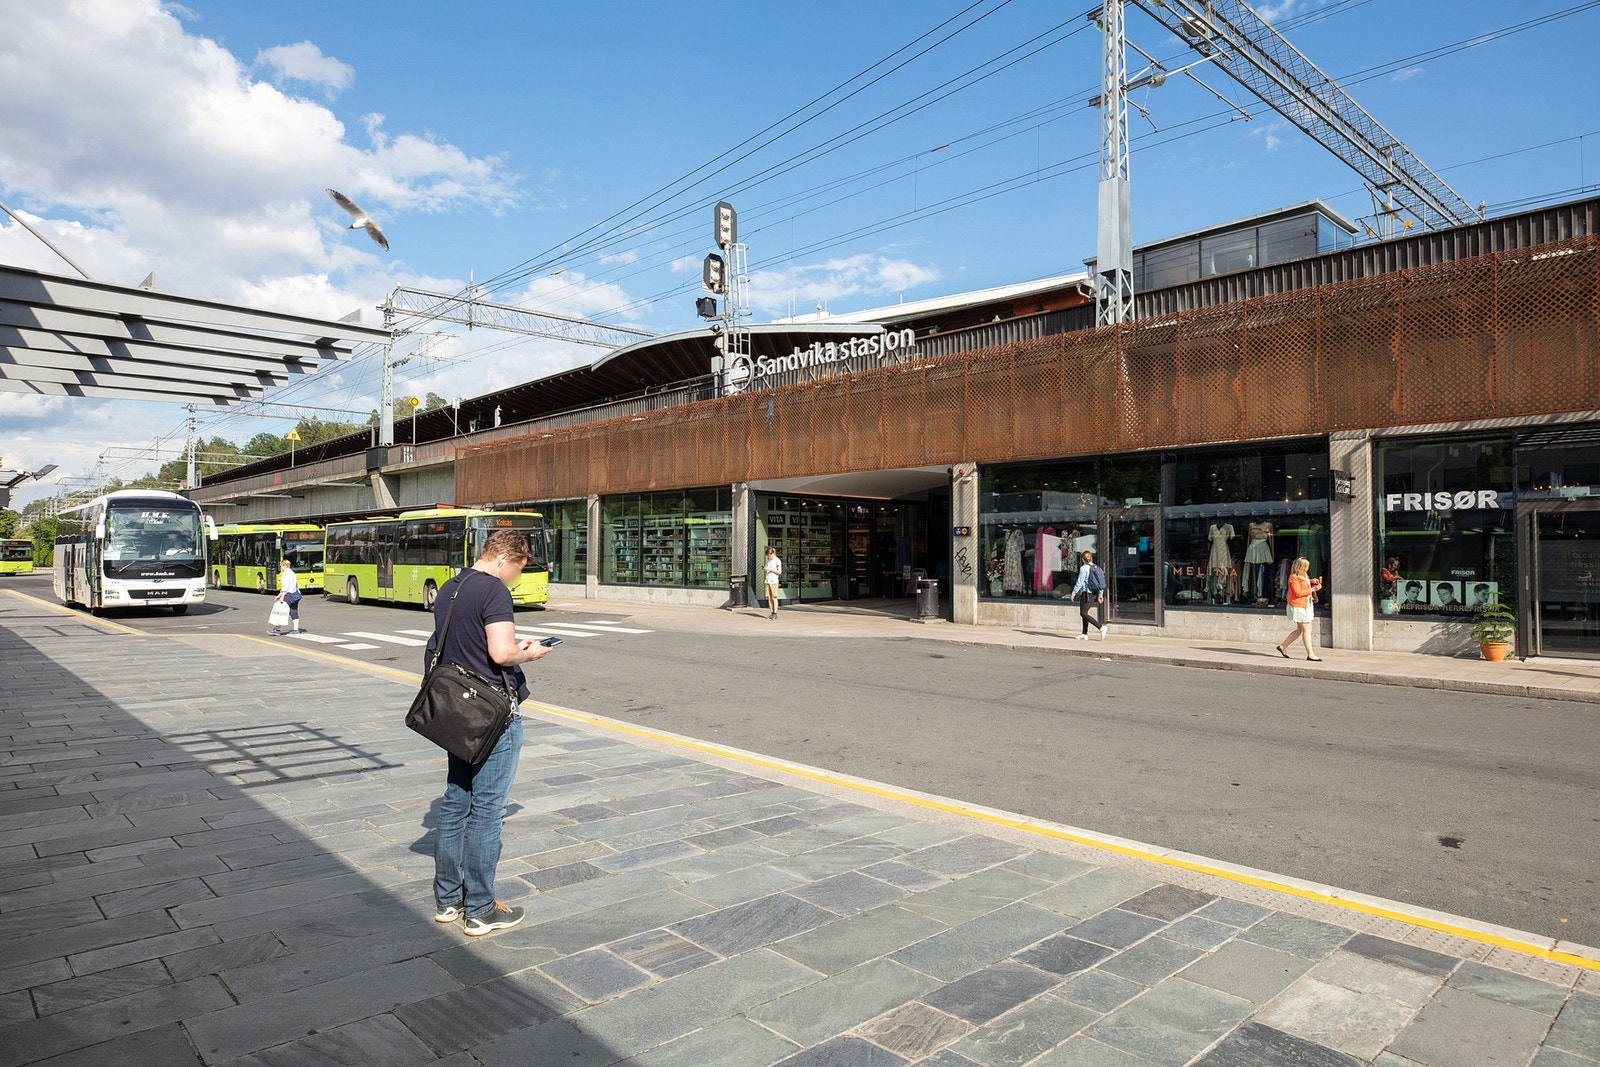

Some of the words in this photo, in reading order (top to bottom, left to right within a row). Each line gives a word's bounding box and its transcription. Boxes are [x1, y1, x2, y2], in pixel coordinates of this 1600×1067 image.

[756, 341, 840, 377] Sandvika
[839, 327, 916, 361] stasjon
[1387, 490, 1499, 511] FRISØR
[769, 515, 784, 523] VITA
[792, 516, 806, 524] VIA
[1172, 566, 1239, 577] MELINA
